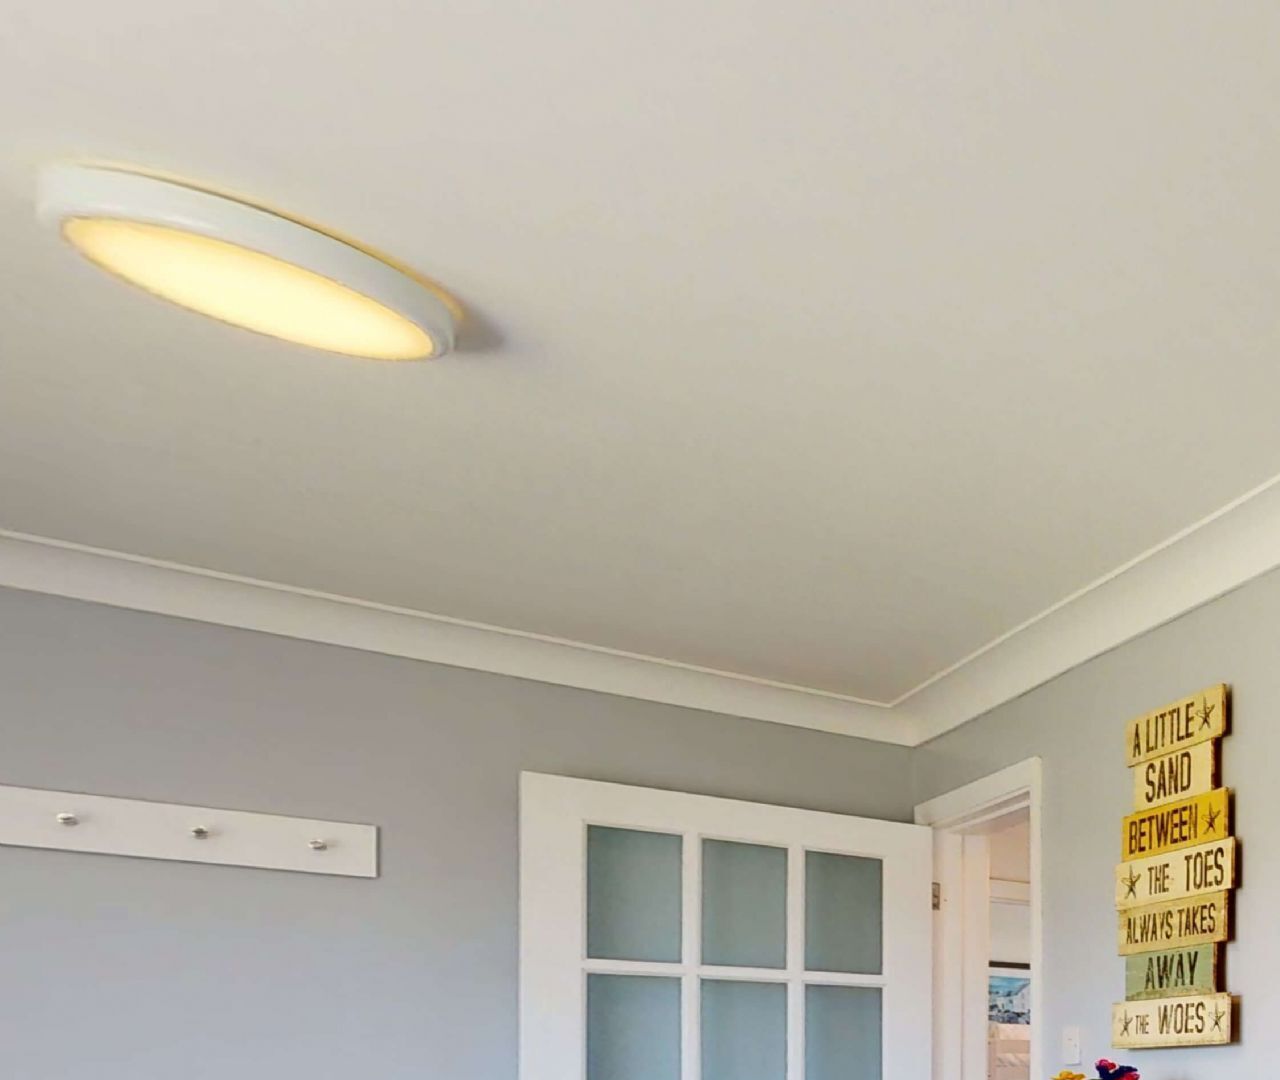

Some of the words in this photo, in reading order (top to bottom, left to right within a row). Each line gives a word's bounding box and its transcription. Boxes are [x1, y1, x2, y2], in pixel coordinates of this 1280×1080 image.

[1132, 723, 1142, 759] A
[1146, 701, 1195, 754] LITTLE
[1145, 751, 1192, 803] SAND
[1128, 803, 1199, 856] BETWEEN
[1147, 863, 1170, 896] THE
[1184, 847, 1225, 892] TOES
[1126, 910, 1174, 945] ALWAYS
[1177, 902, 1217, 938] TAKES
[1144, 951, 1199, 990] AWAY
[1135, 1015, 1150, 1035] THE
[1158, 1002, 1206, 1035] WOES
